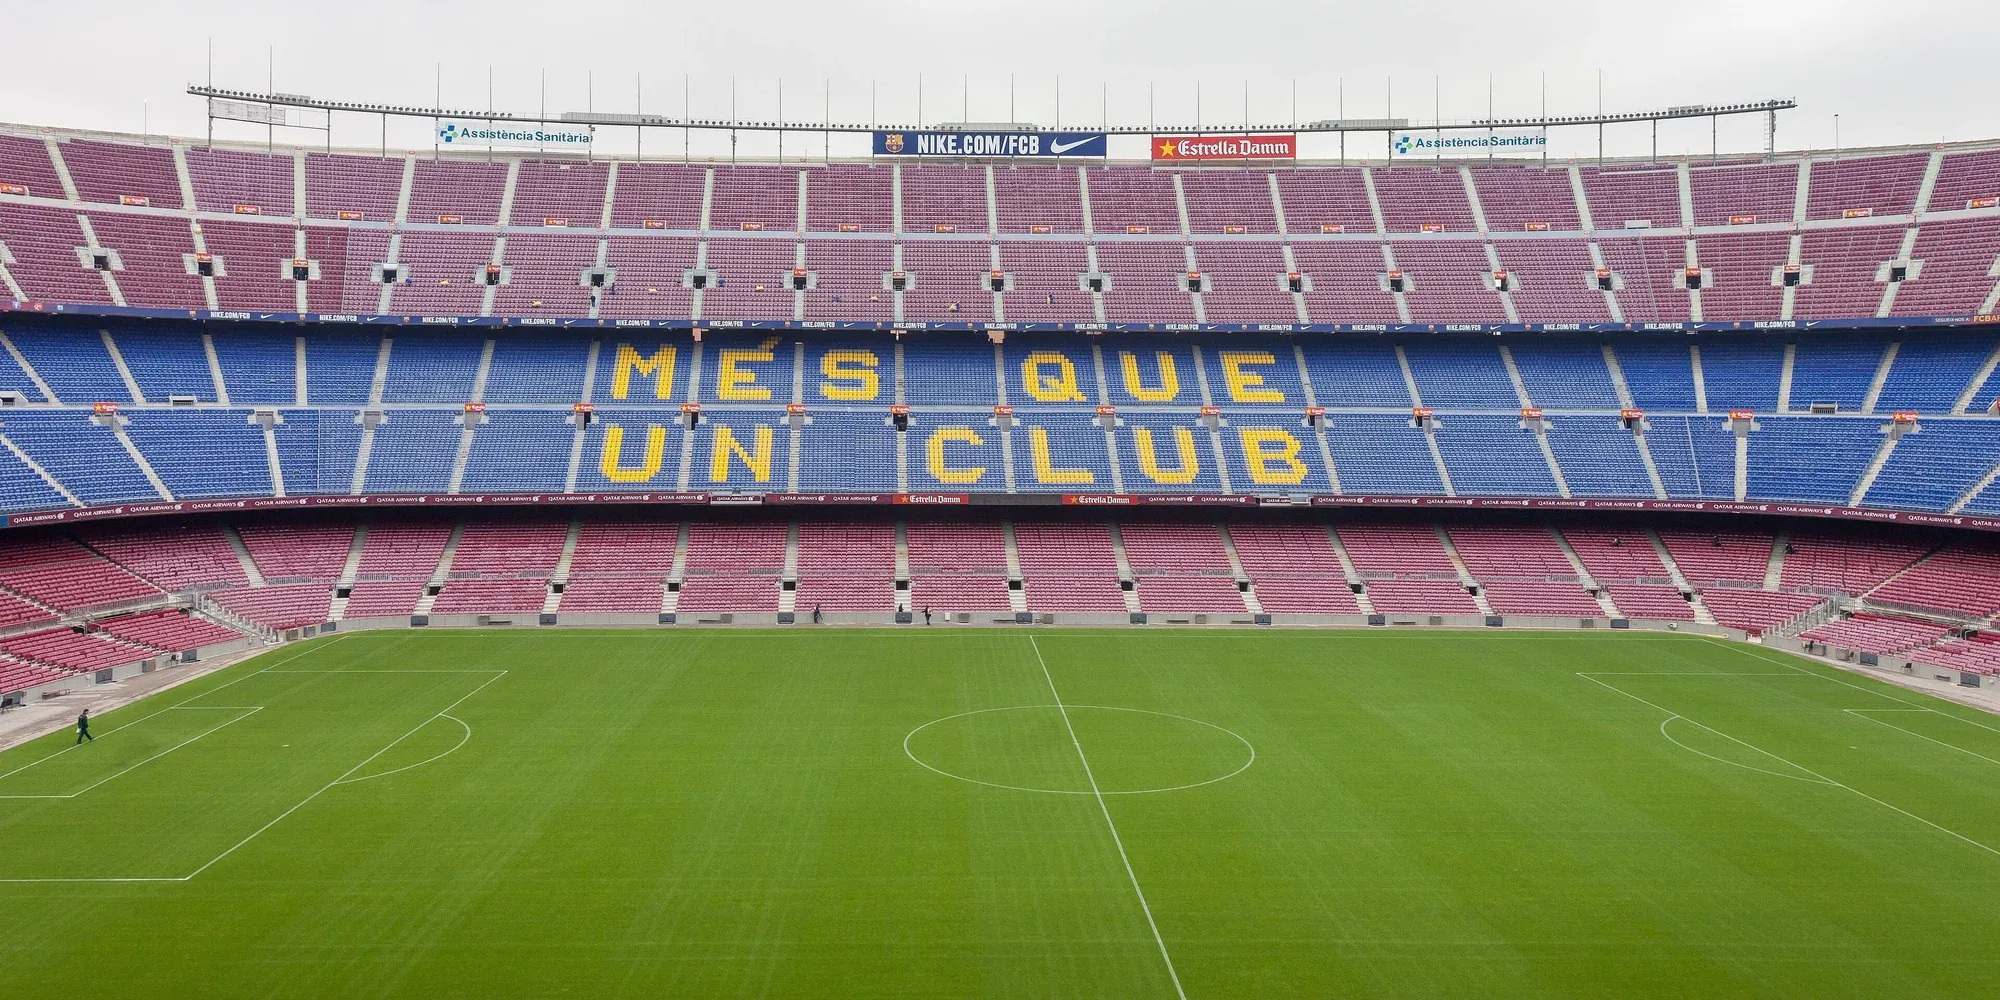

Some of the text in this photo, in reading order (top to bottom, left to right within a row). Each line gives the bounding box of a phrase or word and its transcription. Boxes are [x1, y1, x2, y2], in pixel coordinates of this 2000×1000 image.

[461, 127, 589, 143] Assistència Sanitària
[1415, 135, 1546, 148] Assistència Sanitària
[917, 134, 1040, 155] NIKE.COM/FCB
[1177, 139, 1289, 156] Estrella Damm
[610, 336, 1286, 403] MÉS QUE
[598, 424, 1310, 485] UN CLUB
[910, 496, 937, 504] Estrella
[1079, 496, 1106, 504] Estrella
